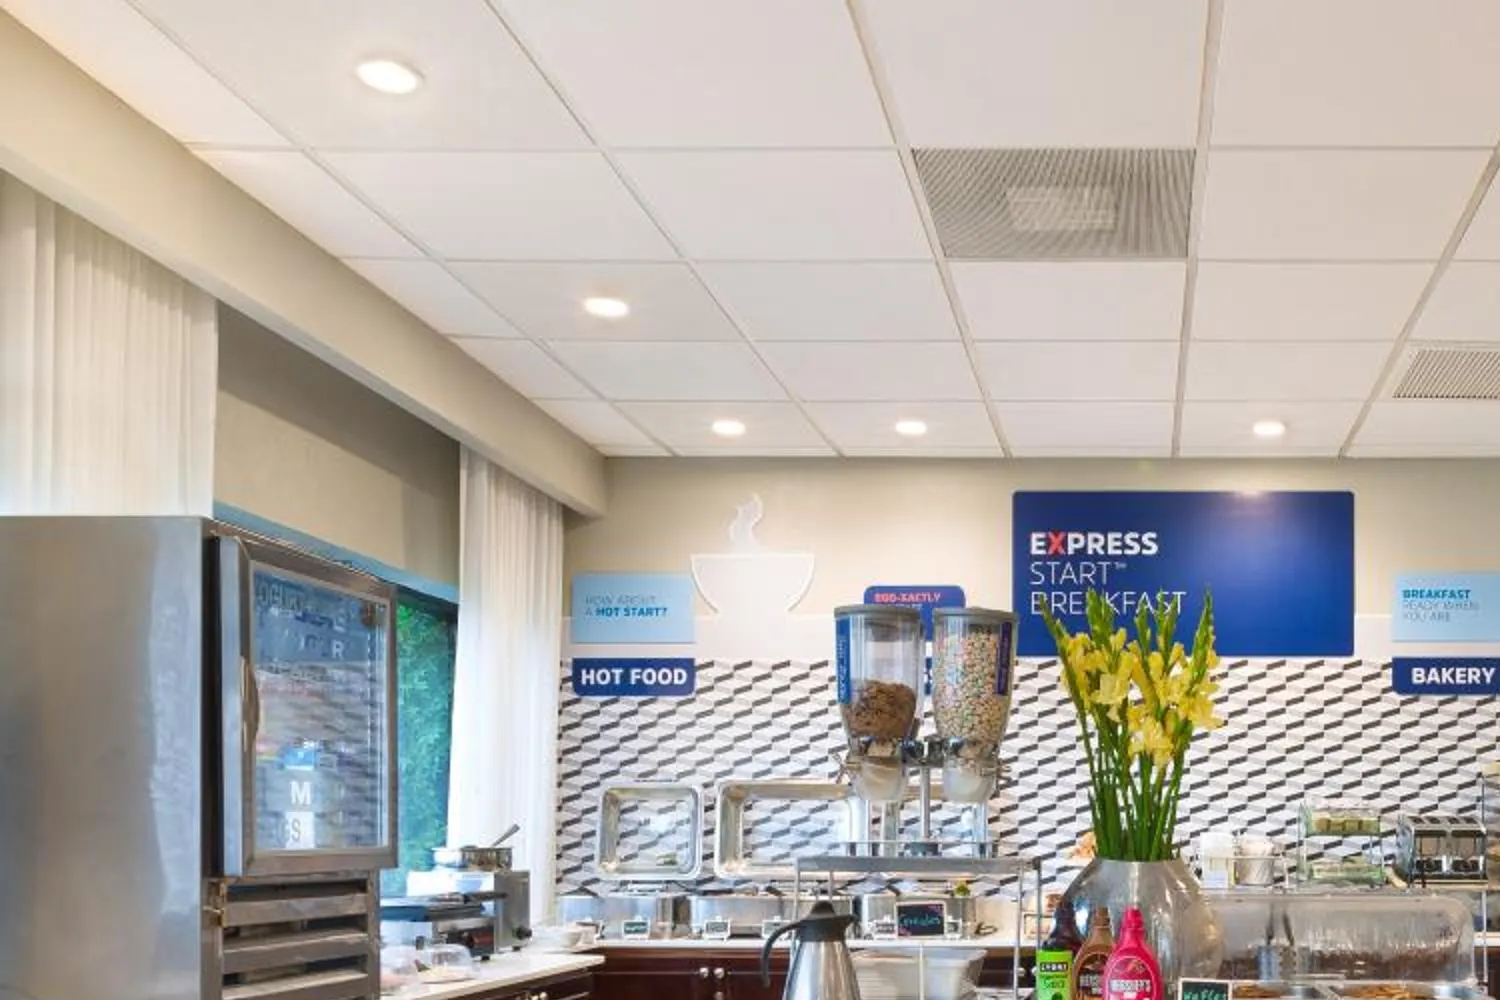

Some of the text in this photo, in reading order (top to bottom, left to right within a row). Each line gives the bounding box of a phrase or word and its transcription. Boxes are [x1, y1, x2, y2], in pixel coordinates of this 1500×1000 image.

[1030, 531, 1159, 555] EXPRESS
[1031, 591, 1187, 615] BREKFAST
[1402, 589, 1471, 599] BREAKFAST
[595, 607, 620, 617] HOT
[623, 607, 668, 617] START?
[580, 668, 688, 686] HOT FOOD
[1411, 666, 1497, 685] BAKERY
